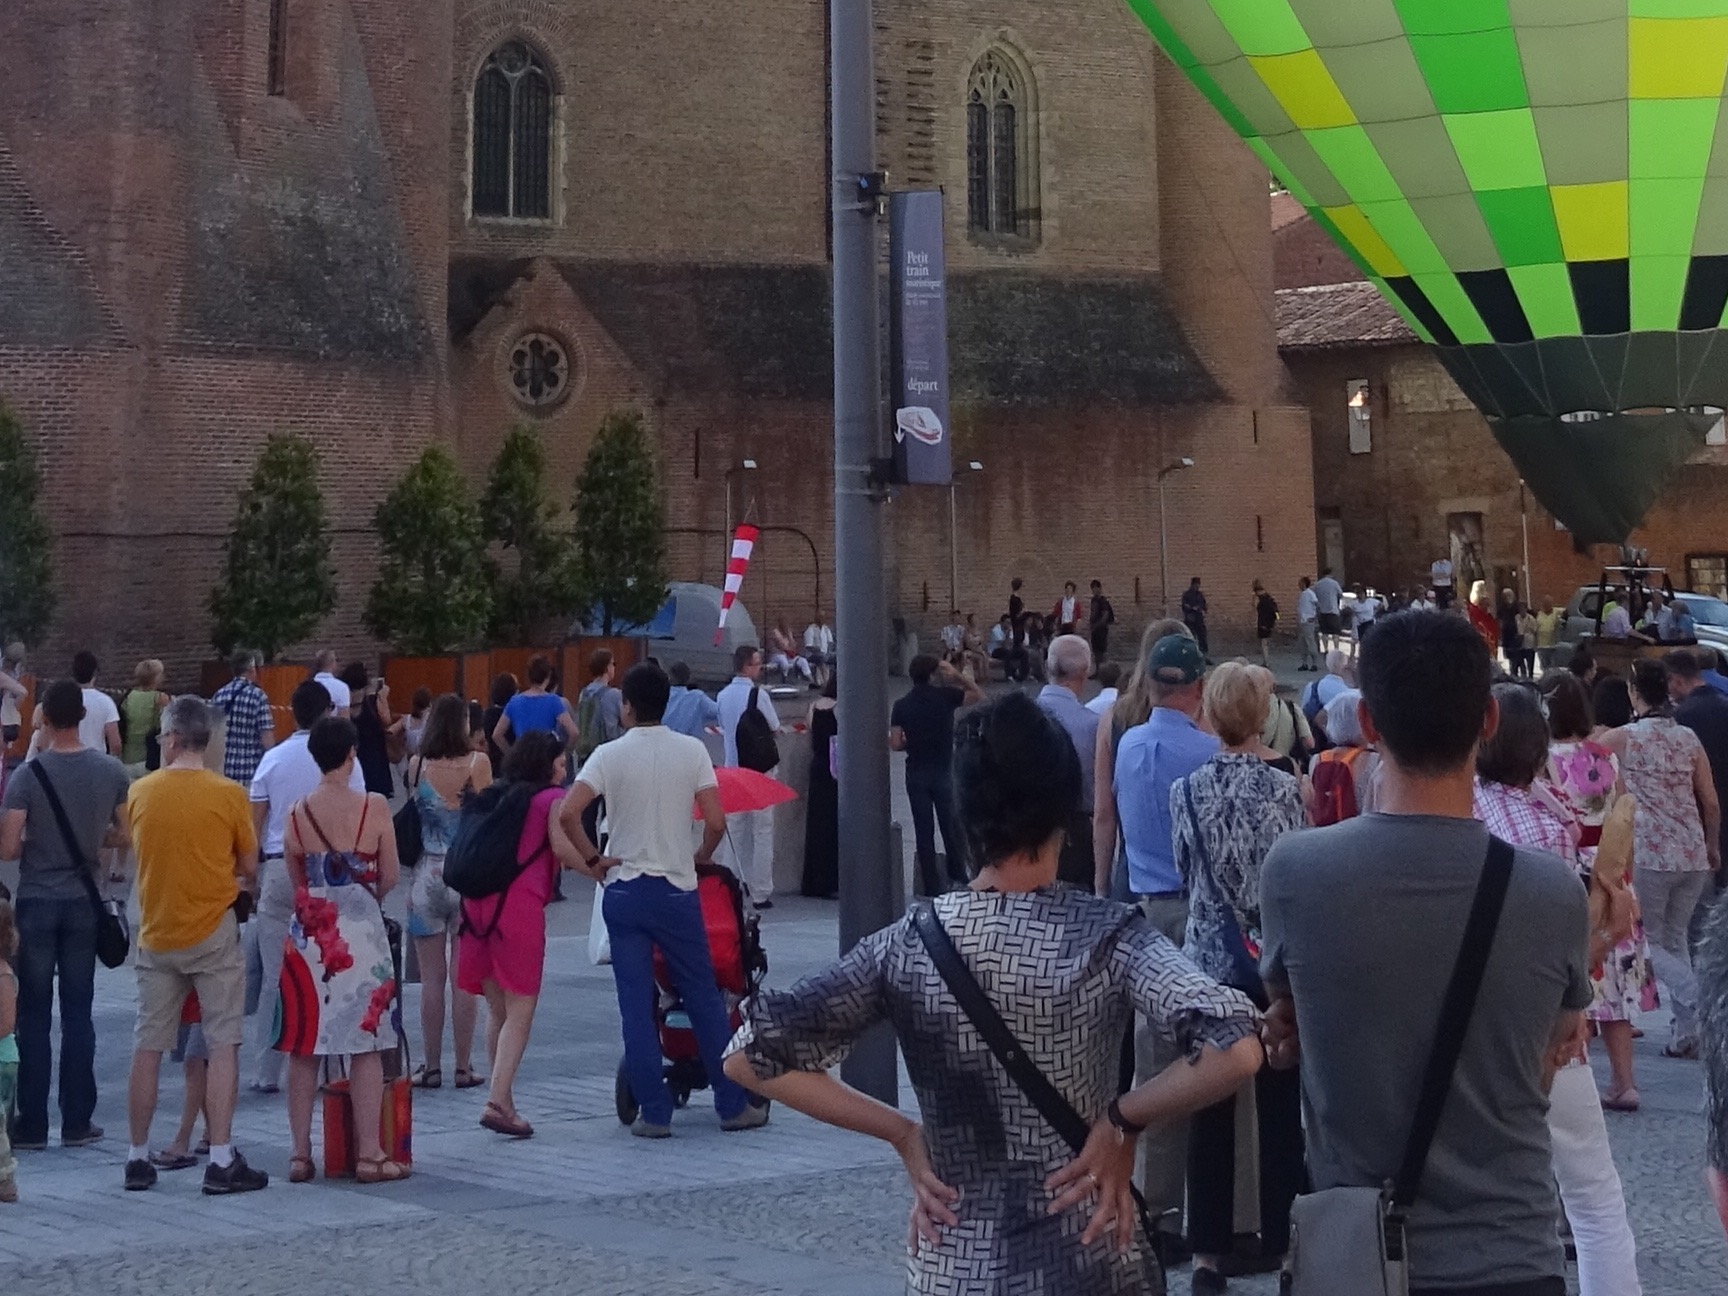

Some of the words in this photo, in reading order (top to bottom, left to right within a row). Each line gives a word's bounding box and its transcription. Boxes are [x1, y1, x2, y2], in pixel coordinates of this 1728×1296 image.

[906, 250, 929, 265] Petit
[906, 264, 929, 277] train
[907, 376, 939, 395] départ
